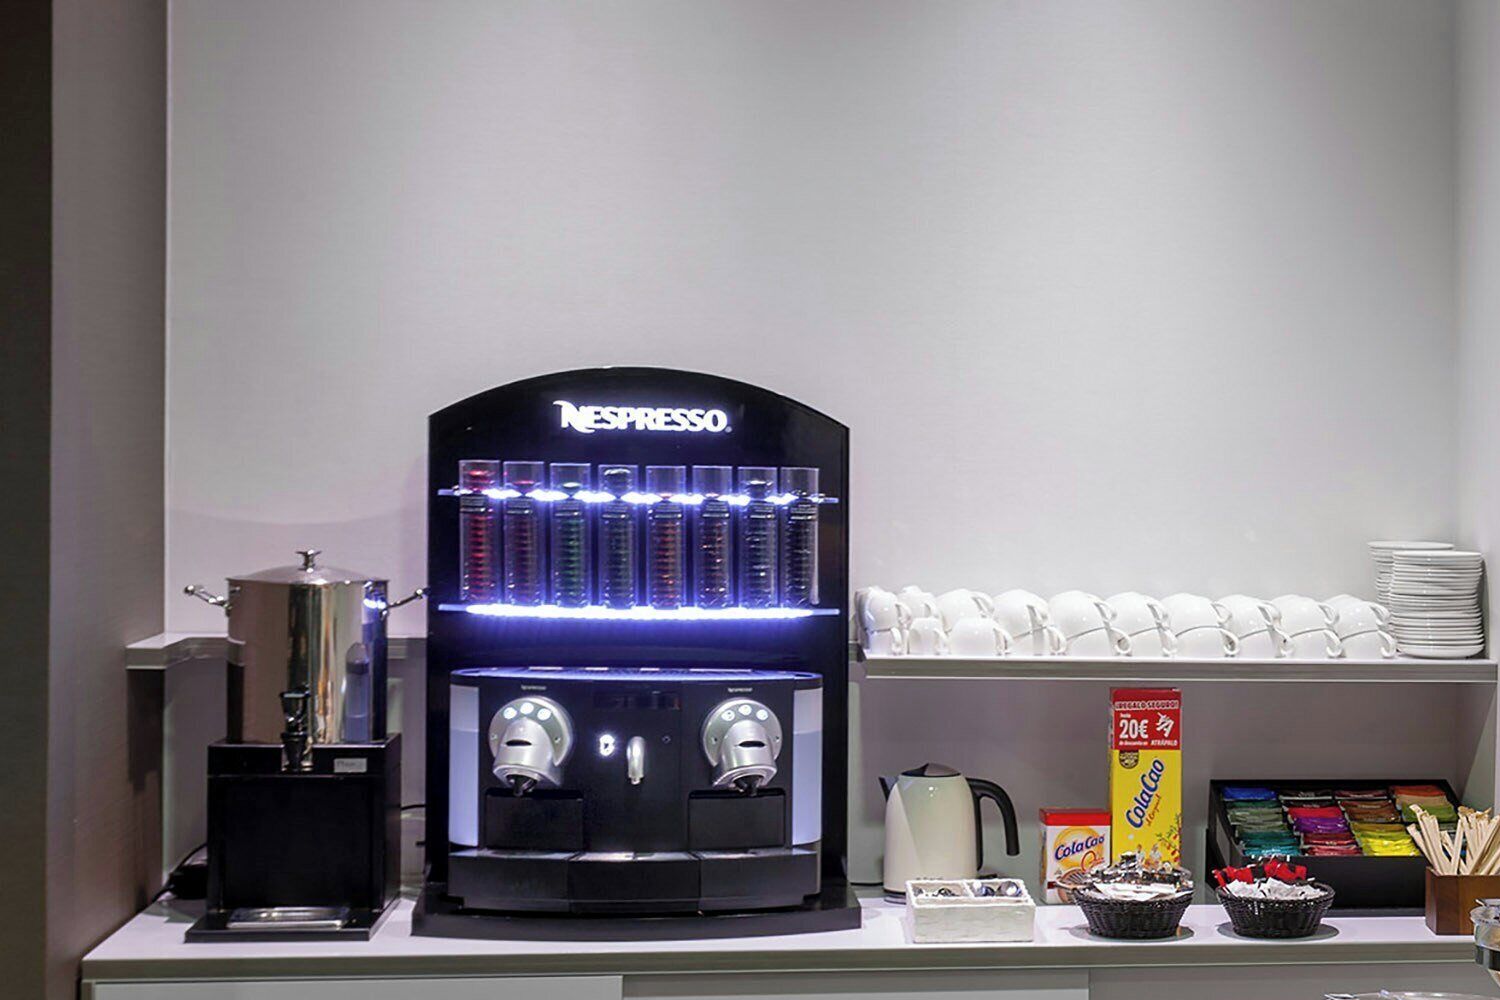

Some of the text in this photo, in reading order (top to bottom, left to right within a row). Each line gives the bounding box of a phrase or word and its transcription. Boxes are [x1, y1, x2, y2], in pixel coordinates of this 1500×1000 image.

[553, 400, 729, 433] NESPRESSO
[1119, 719, 1149, 739] 20€
[1125, 759, 1165, 829] ColaCao
